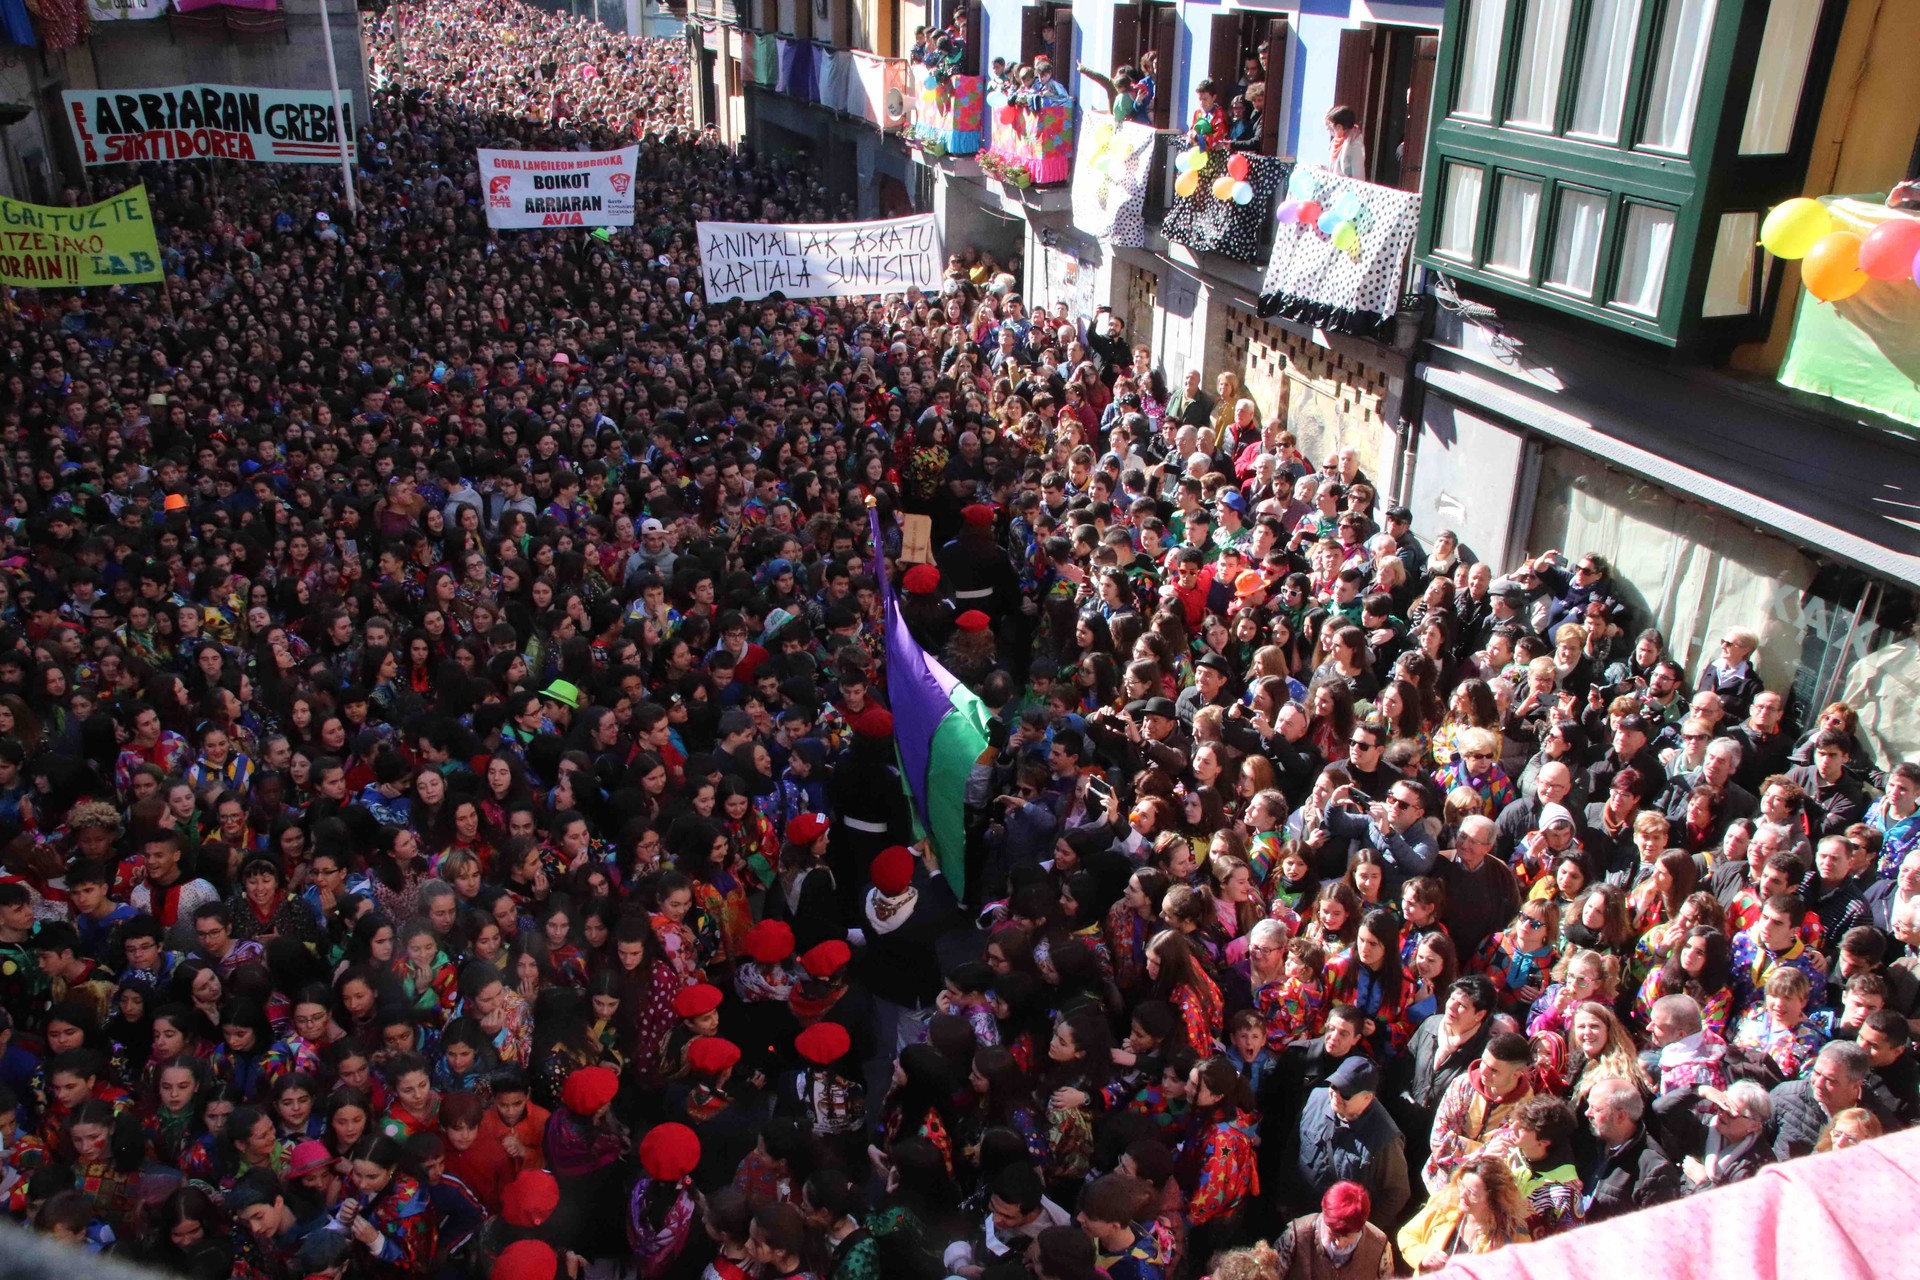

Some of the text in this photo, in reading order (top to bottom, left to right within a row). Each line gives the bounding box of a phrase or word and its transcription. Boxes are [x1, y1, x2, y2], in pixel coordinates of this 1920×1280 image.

[96, 87, 263, 135] ARRIARAN
[71, 101, 98, 163] ELA
[493, 154, 623, 171] GORA LANGILEON BORROKA
[533, 172, 591, 190] BOIKOT
[2, 197, 144, 232] GAITUZTE
[525, 195, 602, 214] ARRIARAN
[541, 211, 584, 226] AVIA
[706, 224, 934, 262] ANIMALIAK ASKATU
[709, 252, 932, 298] KAPITALA SUNTSITU
